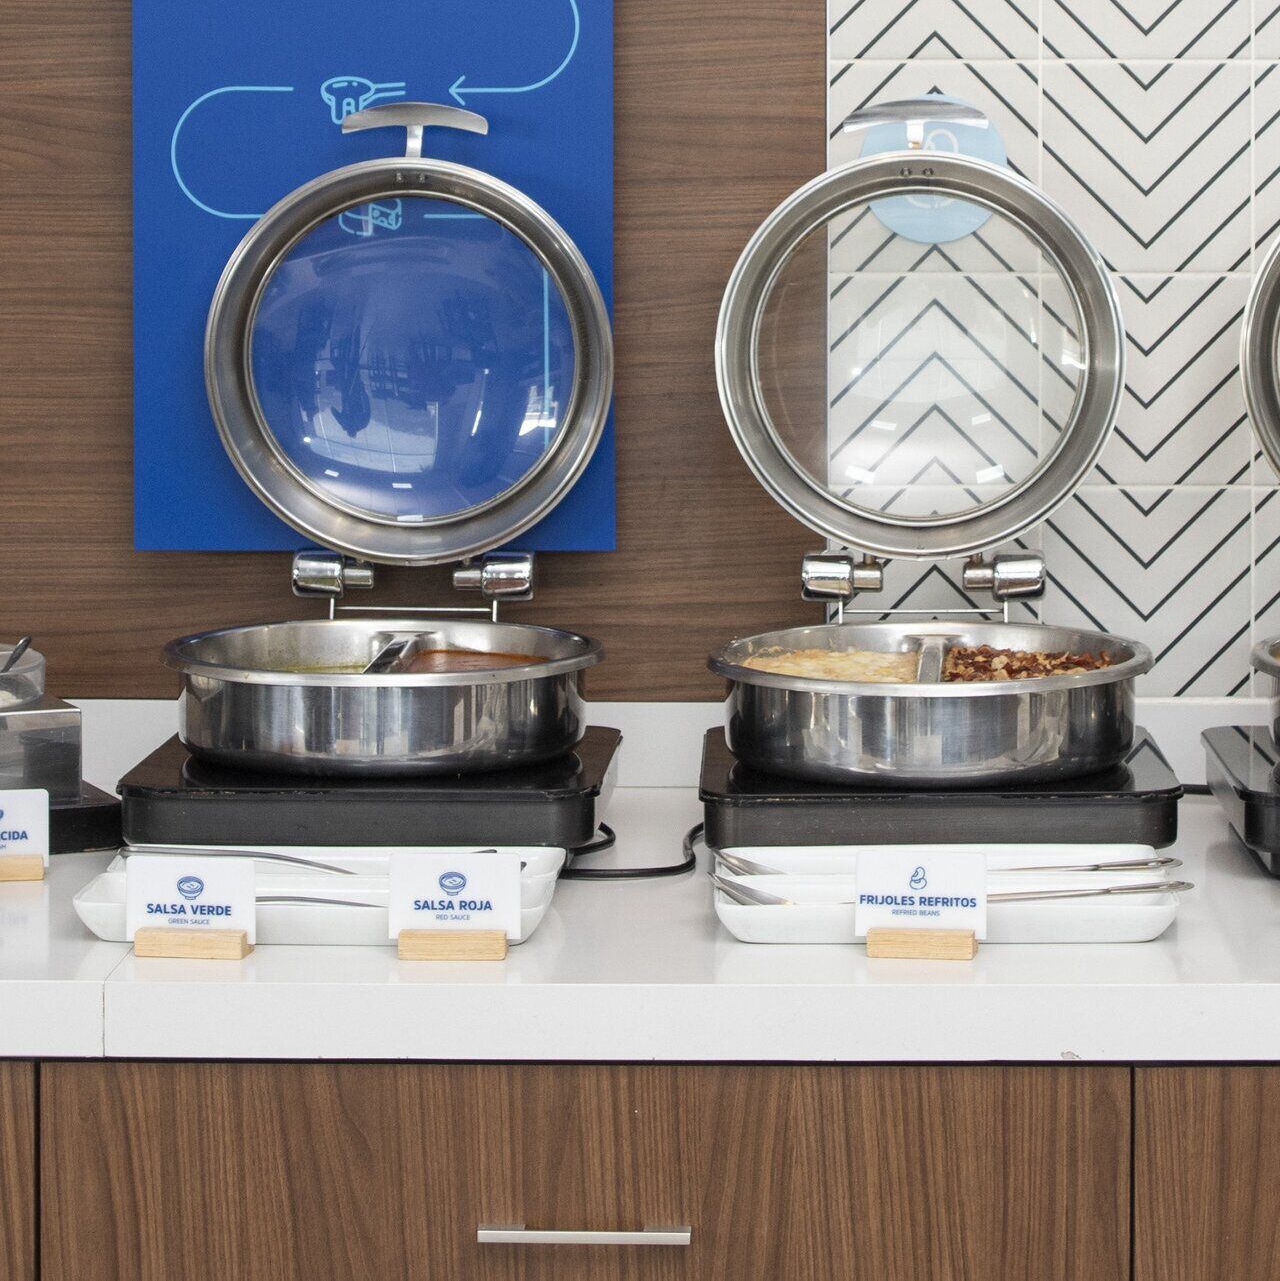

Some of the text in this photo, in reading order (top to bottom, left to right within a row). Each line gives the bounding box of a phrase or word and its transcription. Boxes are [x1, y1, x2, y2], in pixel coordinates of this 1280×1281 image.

[414, 900, 493, 911] SALSA ROJA
[859, 894, 977, 908] FRIJOLES REFRITOS
[146, 903, 232, 916] SALSA VERDE
